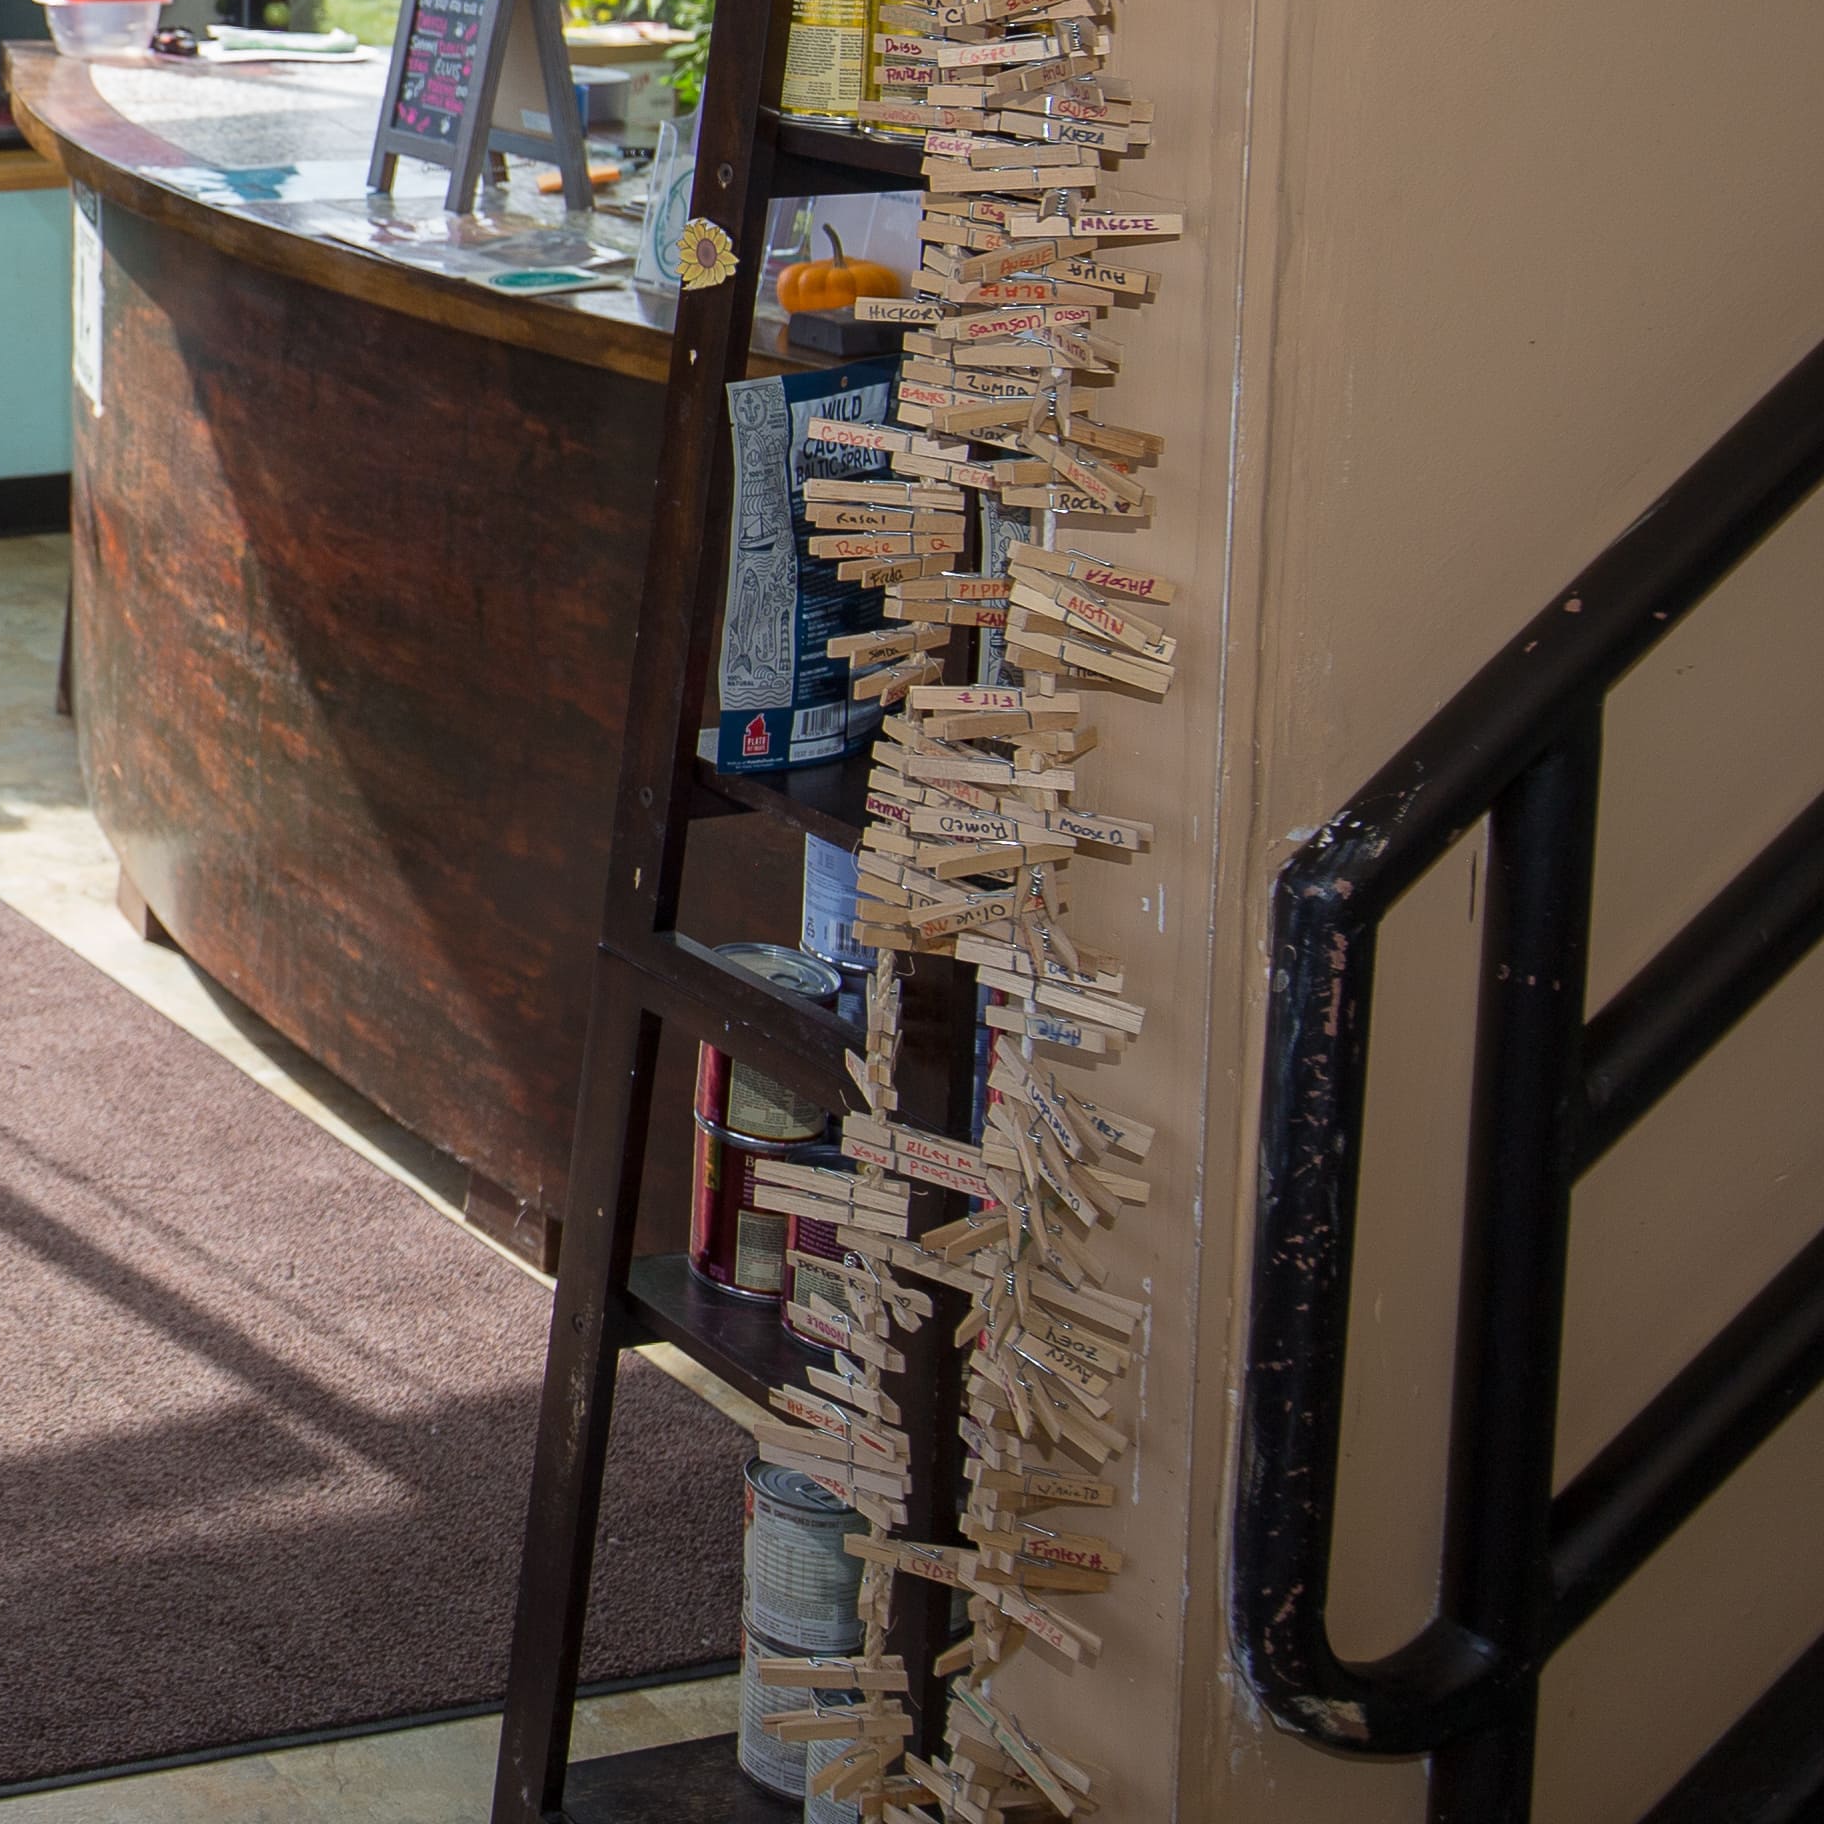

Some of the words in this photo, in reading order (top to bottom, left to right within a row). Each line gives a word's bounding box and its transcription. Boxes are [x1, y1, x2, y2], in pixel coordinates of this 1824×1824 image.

[1081, 217, 1160, 231] MAGGIE
[869, 304, 946, 321] HICKORY
[968, 314, 1042, 338] Samson
[968, 374, 1030, 397] ZUMBA
[821, 395, 863, 420] WILD
[1067, 596, 1125, 635] AUSTIN
[906, 1141, 951, 1165] RILEY
